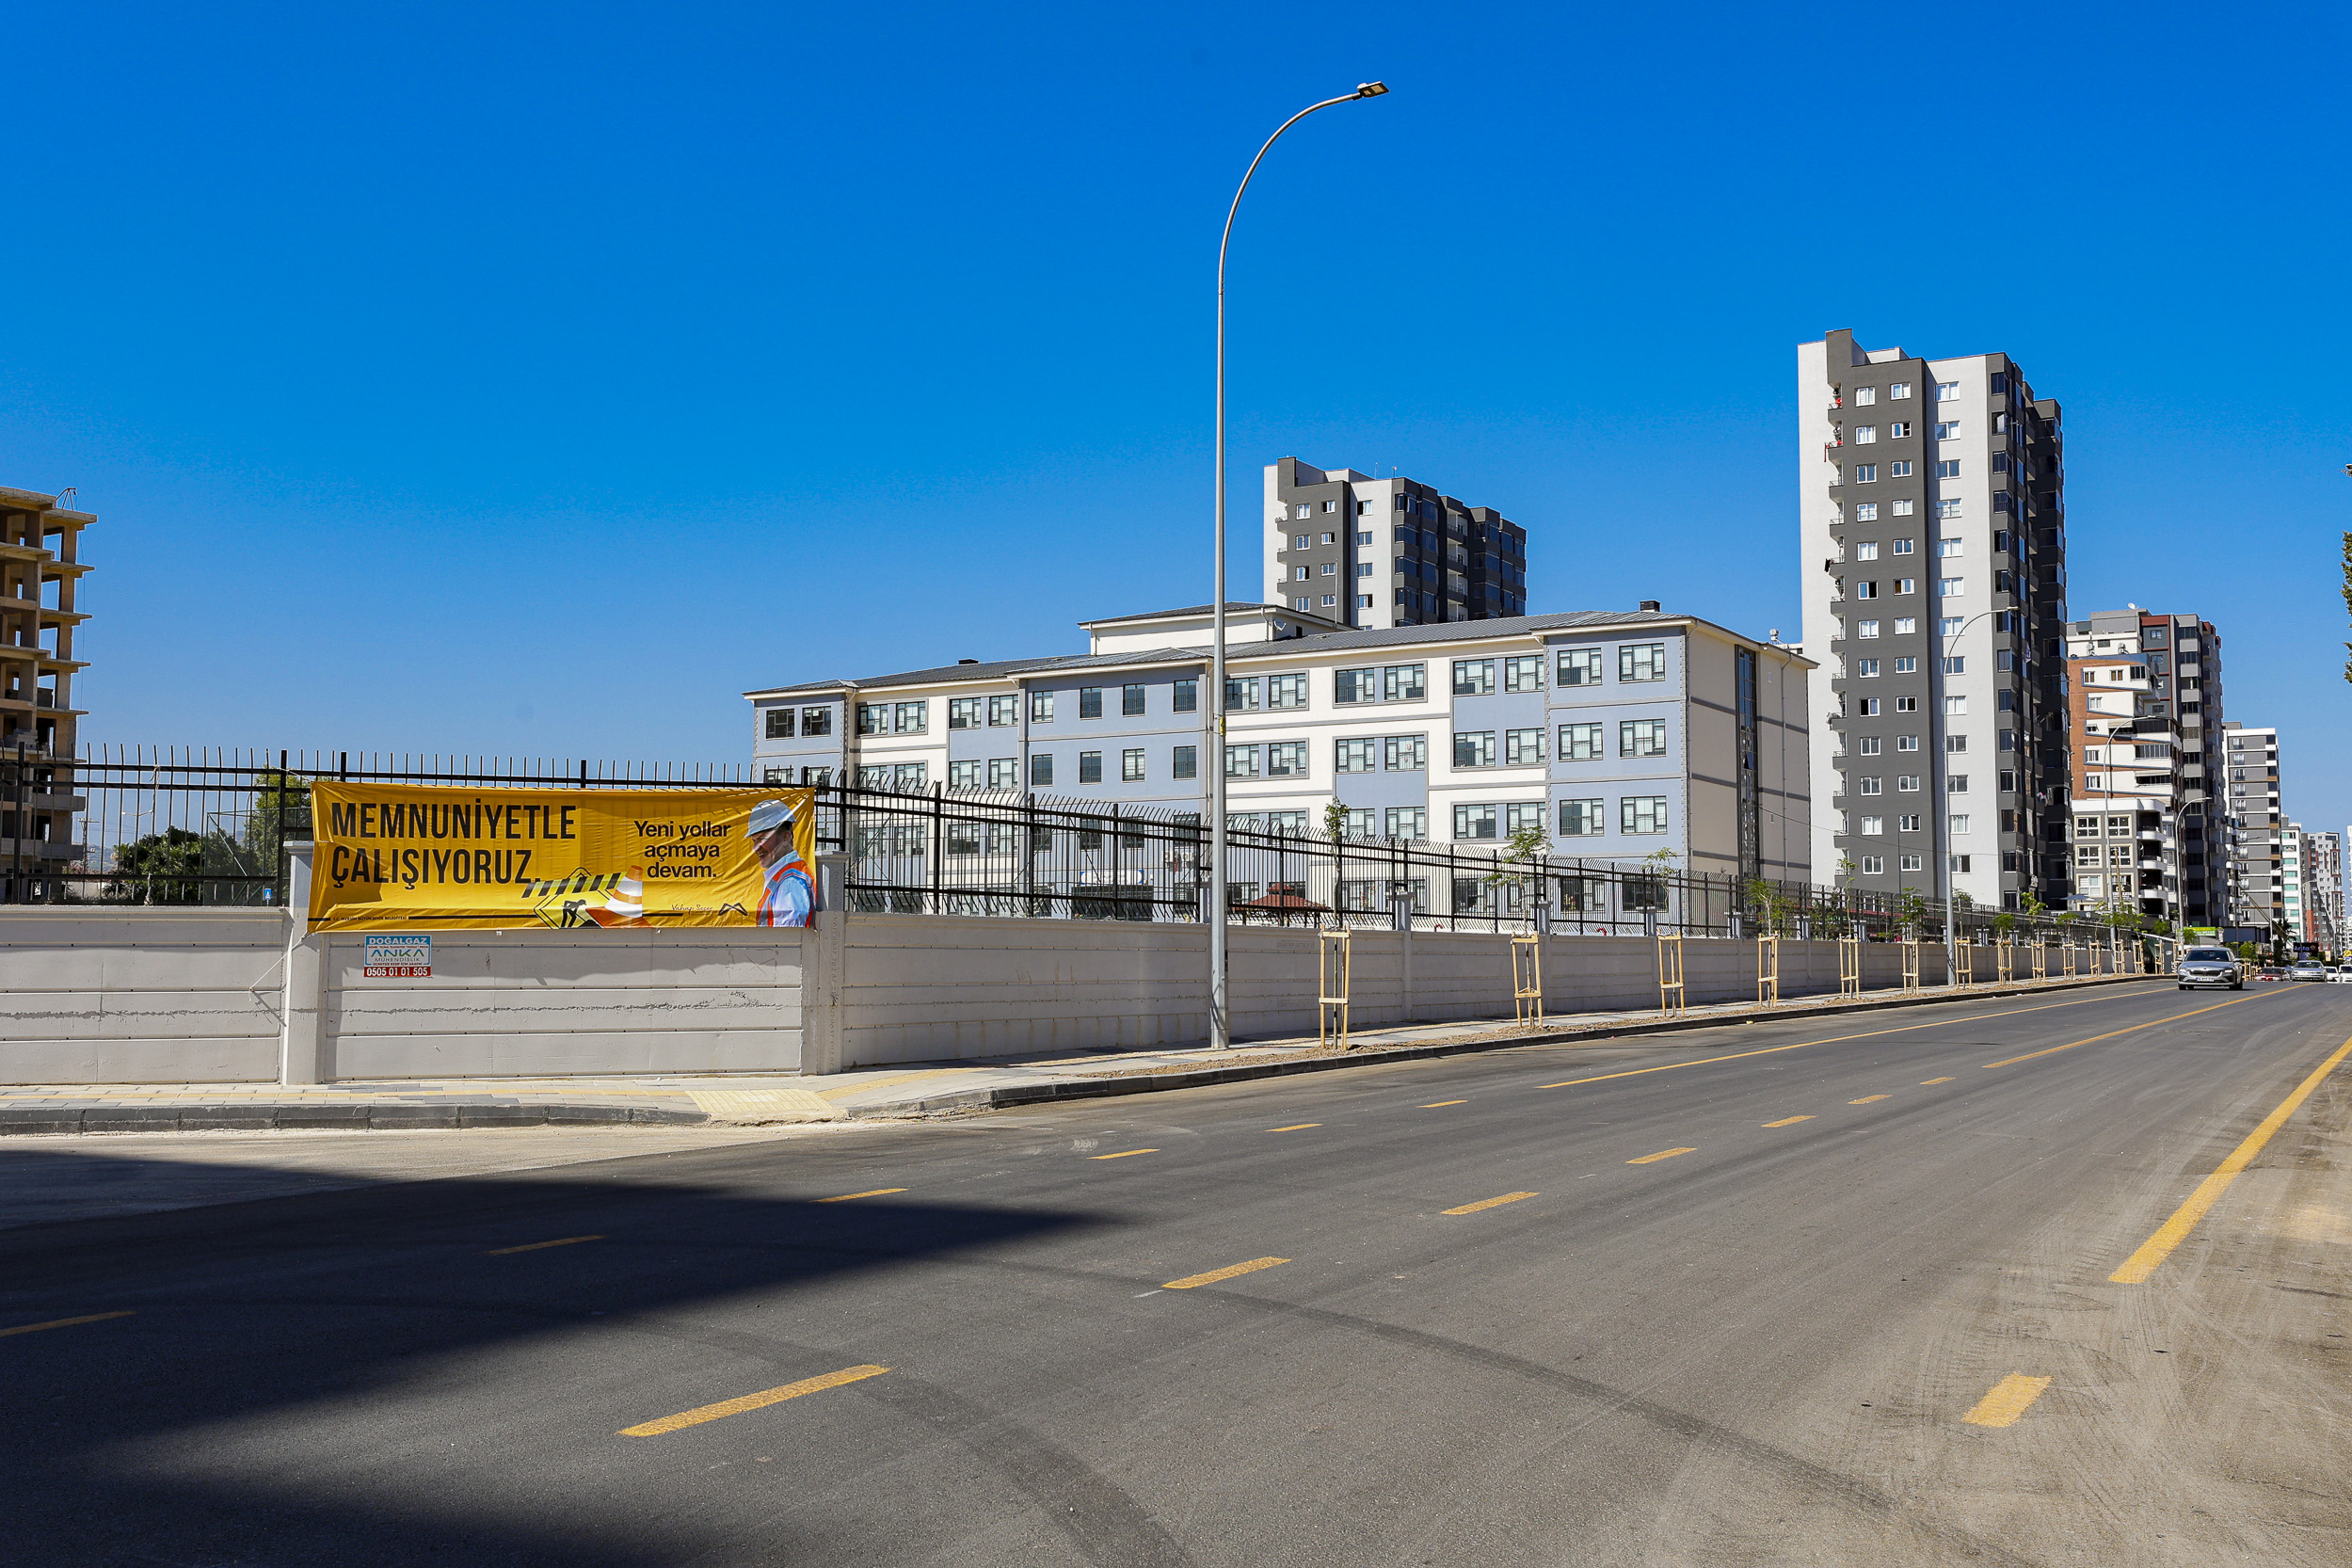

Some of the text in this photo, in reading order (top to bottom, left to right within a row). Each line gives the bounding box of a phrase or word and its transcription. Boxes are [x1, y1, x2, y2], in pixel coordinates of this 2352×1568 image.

[331, 798, 576, 840] MEMNUNİYETLE
[633, 821, 730, 840] Yeni yollar
[645, 844, 720, 862] açmaya
[331, 845, 540, 890] ÇALIŞIYORUZ.
[647, 862, 717, 878] devam.
[369, 936, 427, 945] DOĞALGAZ
[371, 949, 424, 957] ANKA
[366, 967, 428, 976] 0505 01 01 505
